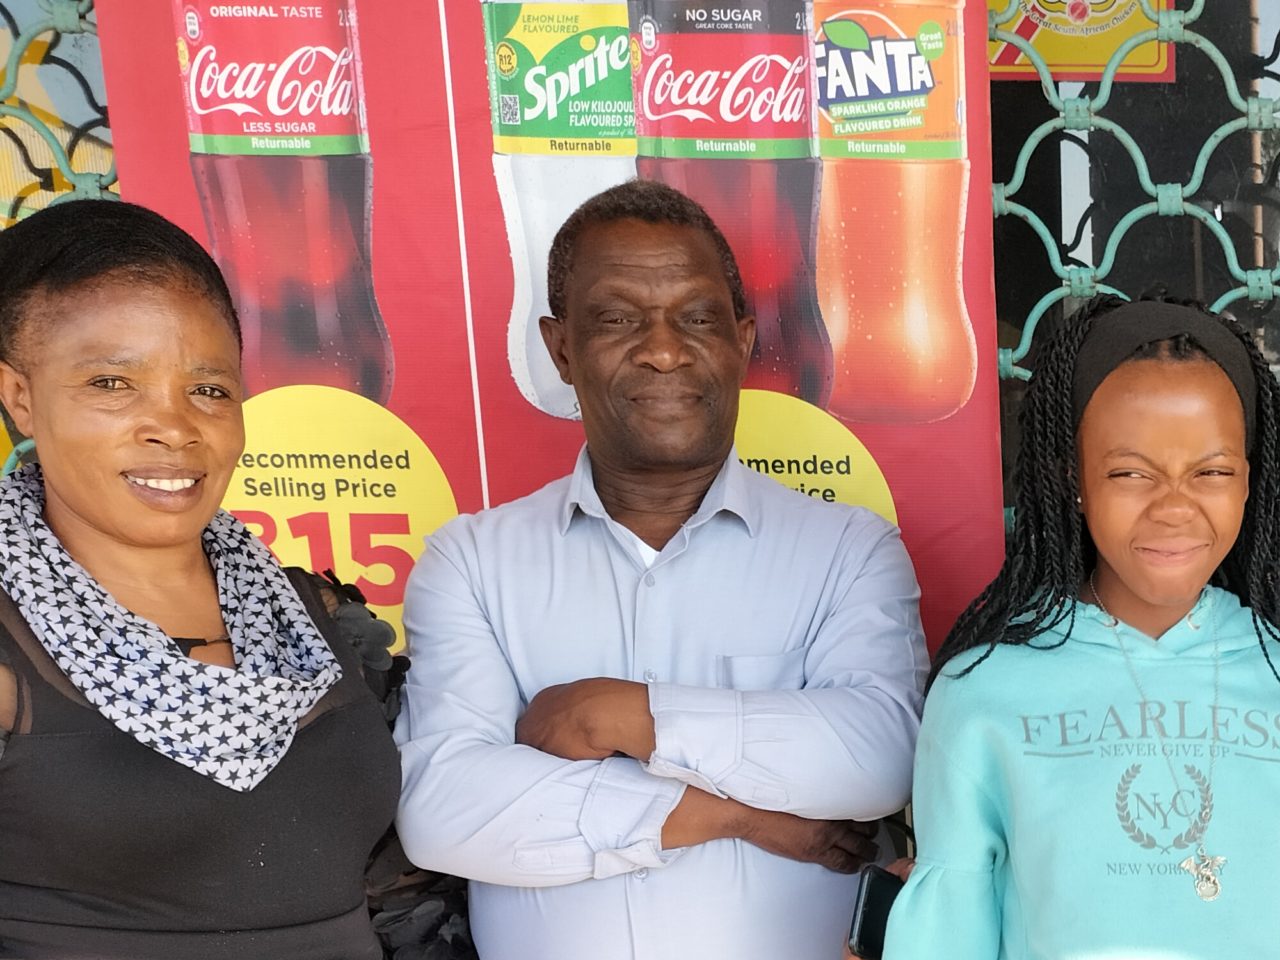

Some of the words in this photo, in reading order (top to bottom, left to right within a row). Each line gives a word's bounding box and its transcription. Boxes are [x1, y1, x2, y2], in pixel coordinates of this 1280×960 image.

[210, 5, 278, 18] ORIGINAL
[281, 6, 323, 18] TASTE
[685, 9, 707, 22] NO
[711, 9, 762, 22] SUGAR
[522, 14, 555, 24] LEMON
[557, 14, 580, 24] LIME
[1031, 12, 1053, 28] Great
[1054, 24, 1077, 35] South
[1080, 22, 1111, 36] African
[1111, 2, 1138, 25] Chicken
[522, 24, 580, 34] FLAVOURED
[919, 32, 942, 42] Great
[921, 40, 943, 50] Taste
[814, 39, 935, 101] FANTA
[189, 45, 354, 116] Coca-Cola
[524, 34, 631, 121] Sprite
[642, 54, 809, 123] Coca-Cola
[568, 100, 589, 113] LOW
[591, 100, 634, 113] KILOJOUL
[831, 102, 886, 117] SPARKLING
[886, 97, 926, 111] ORANGE
[569, 114, 622, 127] FLAVOURED
[833, 119, 892, 134] FLAVOURED
[893, 114, 923, 128] DRINK
[243, 122, 271, 133] LESS
[274, 122, 317, 133] SUGAR
[251, 137, 311, 149] Returnable
[549, 139, 612, 152] Returnable
[695, 139, 757, 152] Returnable
[847, 140, 906, 154] Returnable
[243, 477, 327, 501] Selling
[335, 478, 398, 499] Price
[1100, 743, 1158, 758] NEVER
[1161, 742, 1205, 758] GIVE
[1209, 744, 1231, 758] UP
[1133, 789, 1196, 830] NYC
[1106, 862, 1143, 876] NEW
